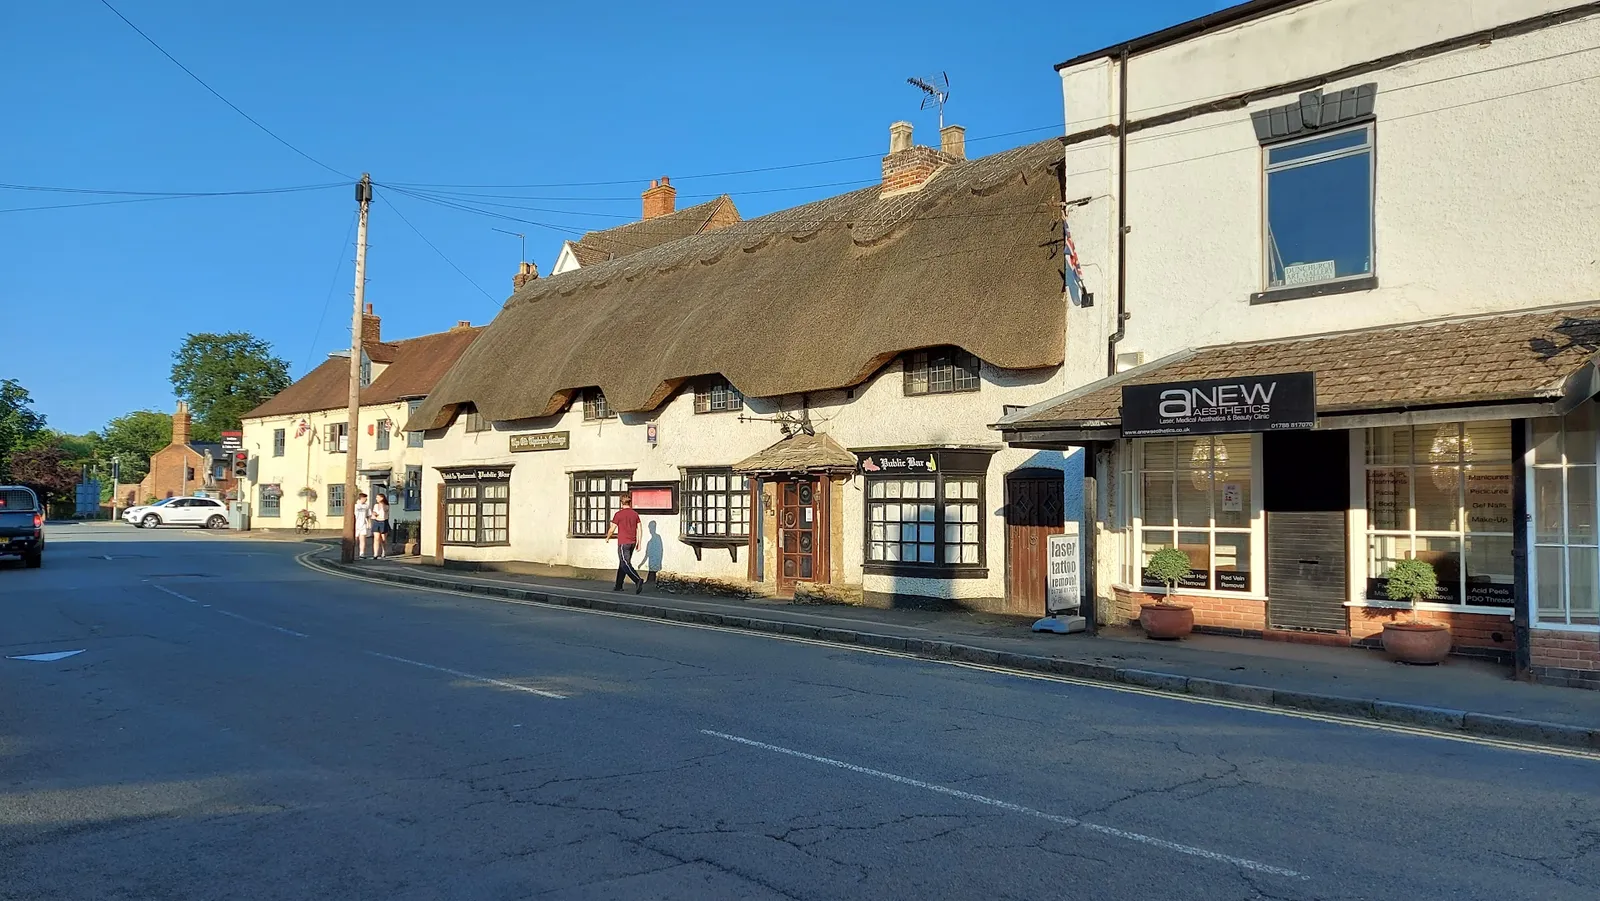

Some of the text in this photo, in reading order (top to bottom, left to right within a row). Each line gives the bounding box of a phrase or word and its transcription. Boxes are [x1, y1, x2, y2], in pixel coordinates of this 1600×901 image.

[1286, 261, 1334, 274] DUNCHURCH
[1303, 268, 1333, 279] GALLERY
[1193, 404, 1270, 416] AESTHETICS
[1197, 414, 1226, 422] Aesthetics
[1233, 413, 1253, 421] Beauty
[880, 456, 924, 470] Public Bar
[478, 470, 510, 479] Public Bar
[1471, 516, 1508, 524] Make-Up
[1051, 540, 1076, 558] laser
[1051, 560, 1077, 575] tattoo
[1051, 575, 1077, 588] removal
[1485, 596, 1515, 604] Threads
